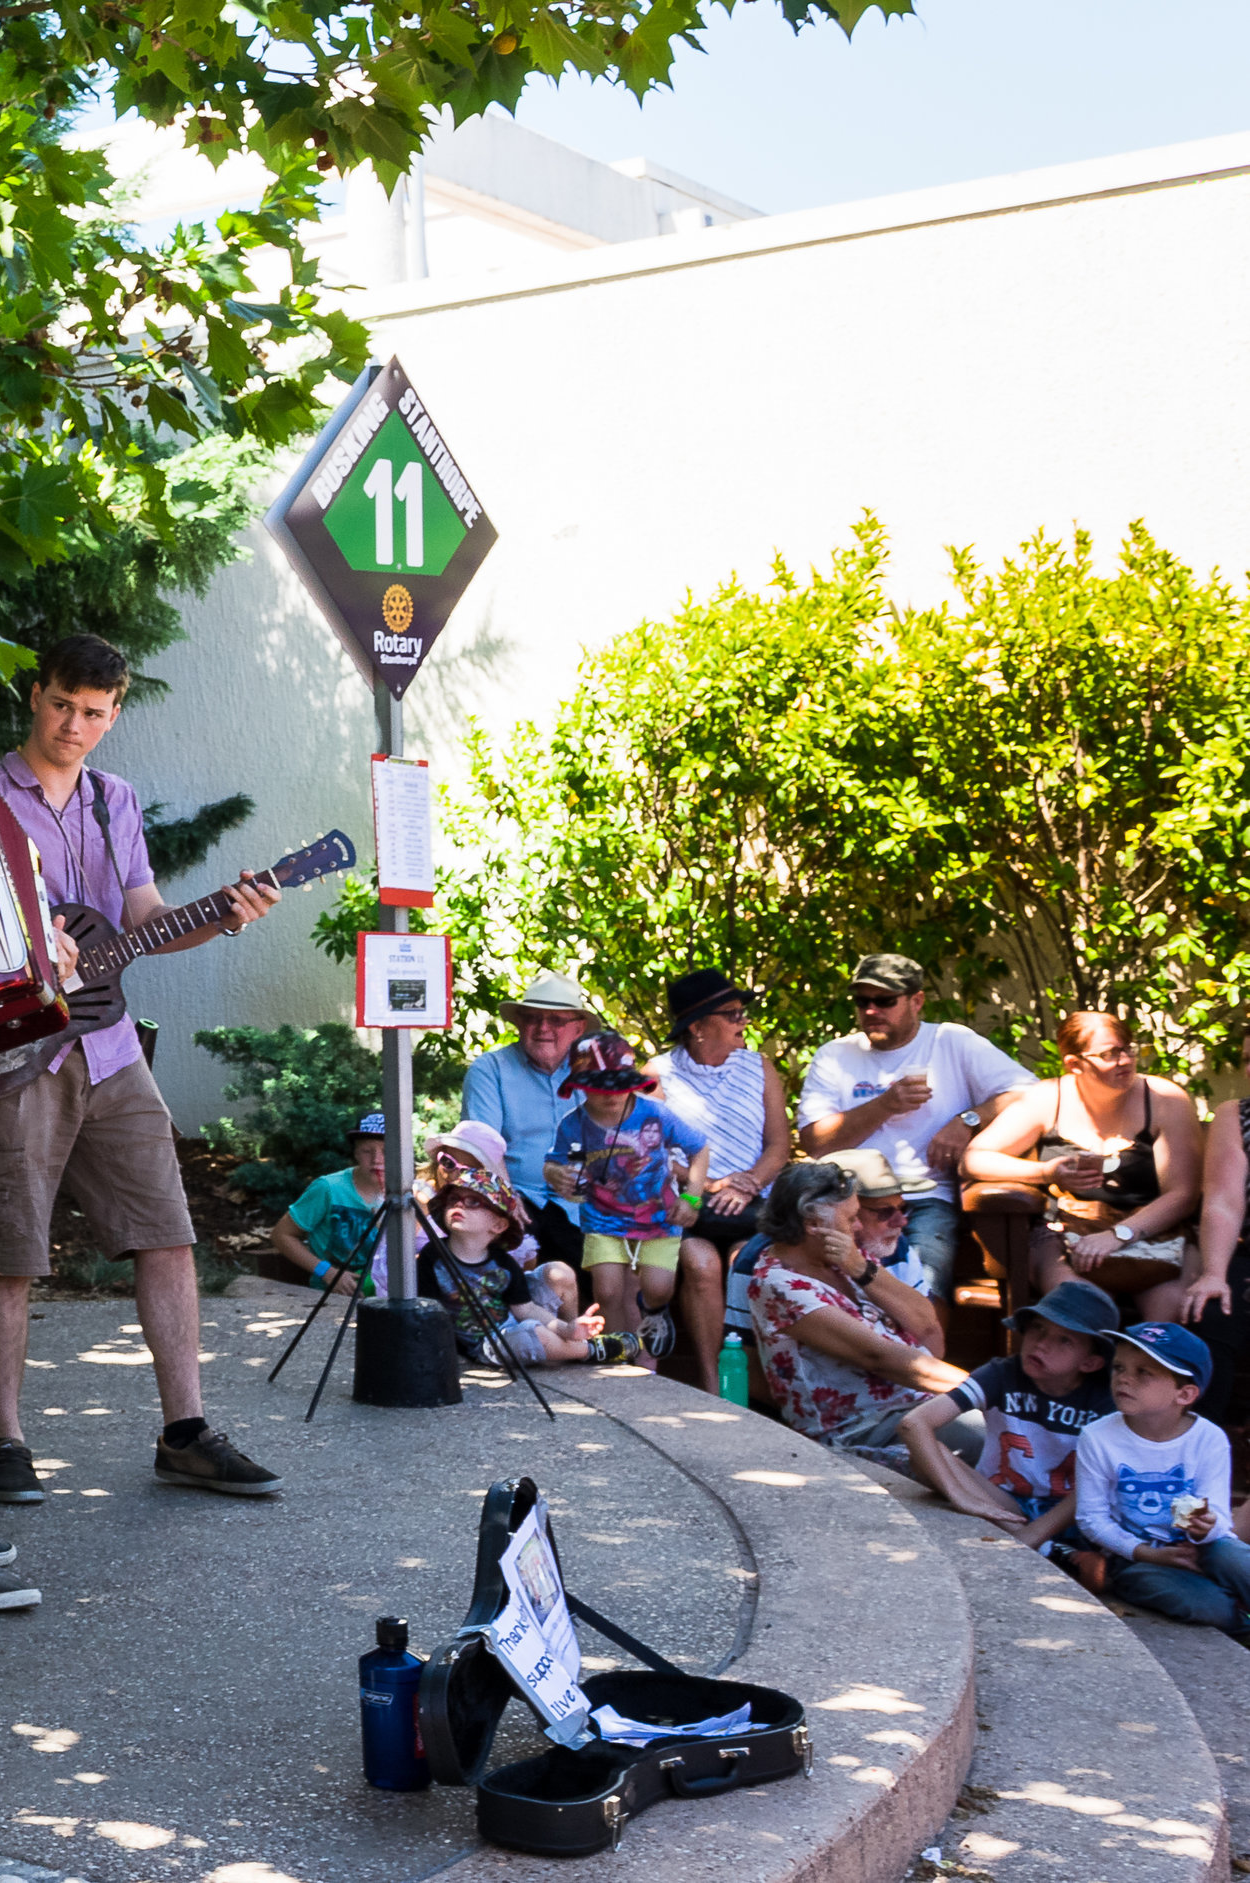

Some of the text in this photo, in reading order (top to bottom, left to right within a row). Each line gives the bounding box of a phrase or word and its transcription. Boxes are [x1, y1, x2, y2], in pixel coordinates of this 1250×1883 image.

[310, 391, 390, 510] BUSKING
[398, 387, 482, 529] STANTHORPE
[363, 458, 424, 568] 11
[374, 630, 423, 658] Rotary
